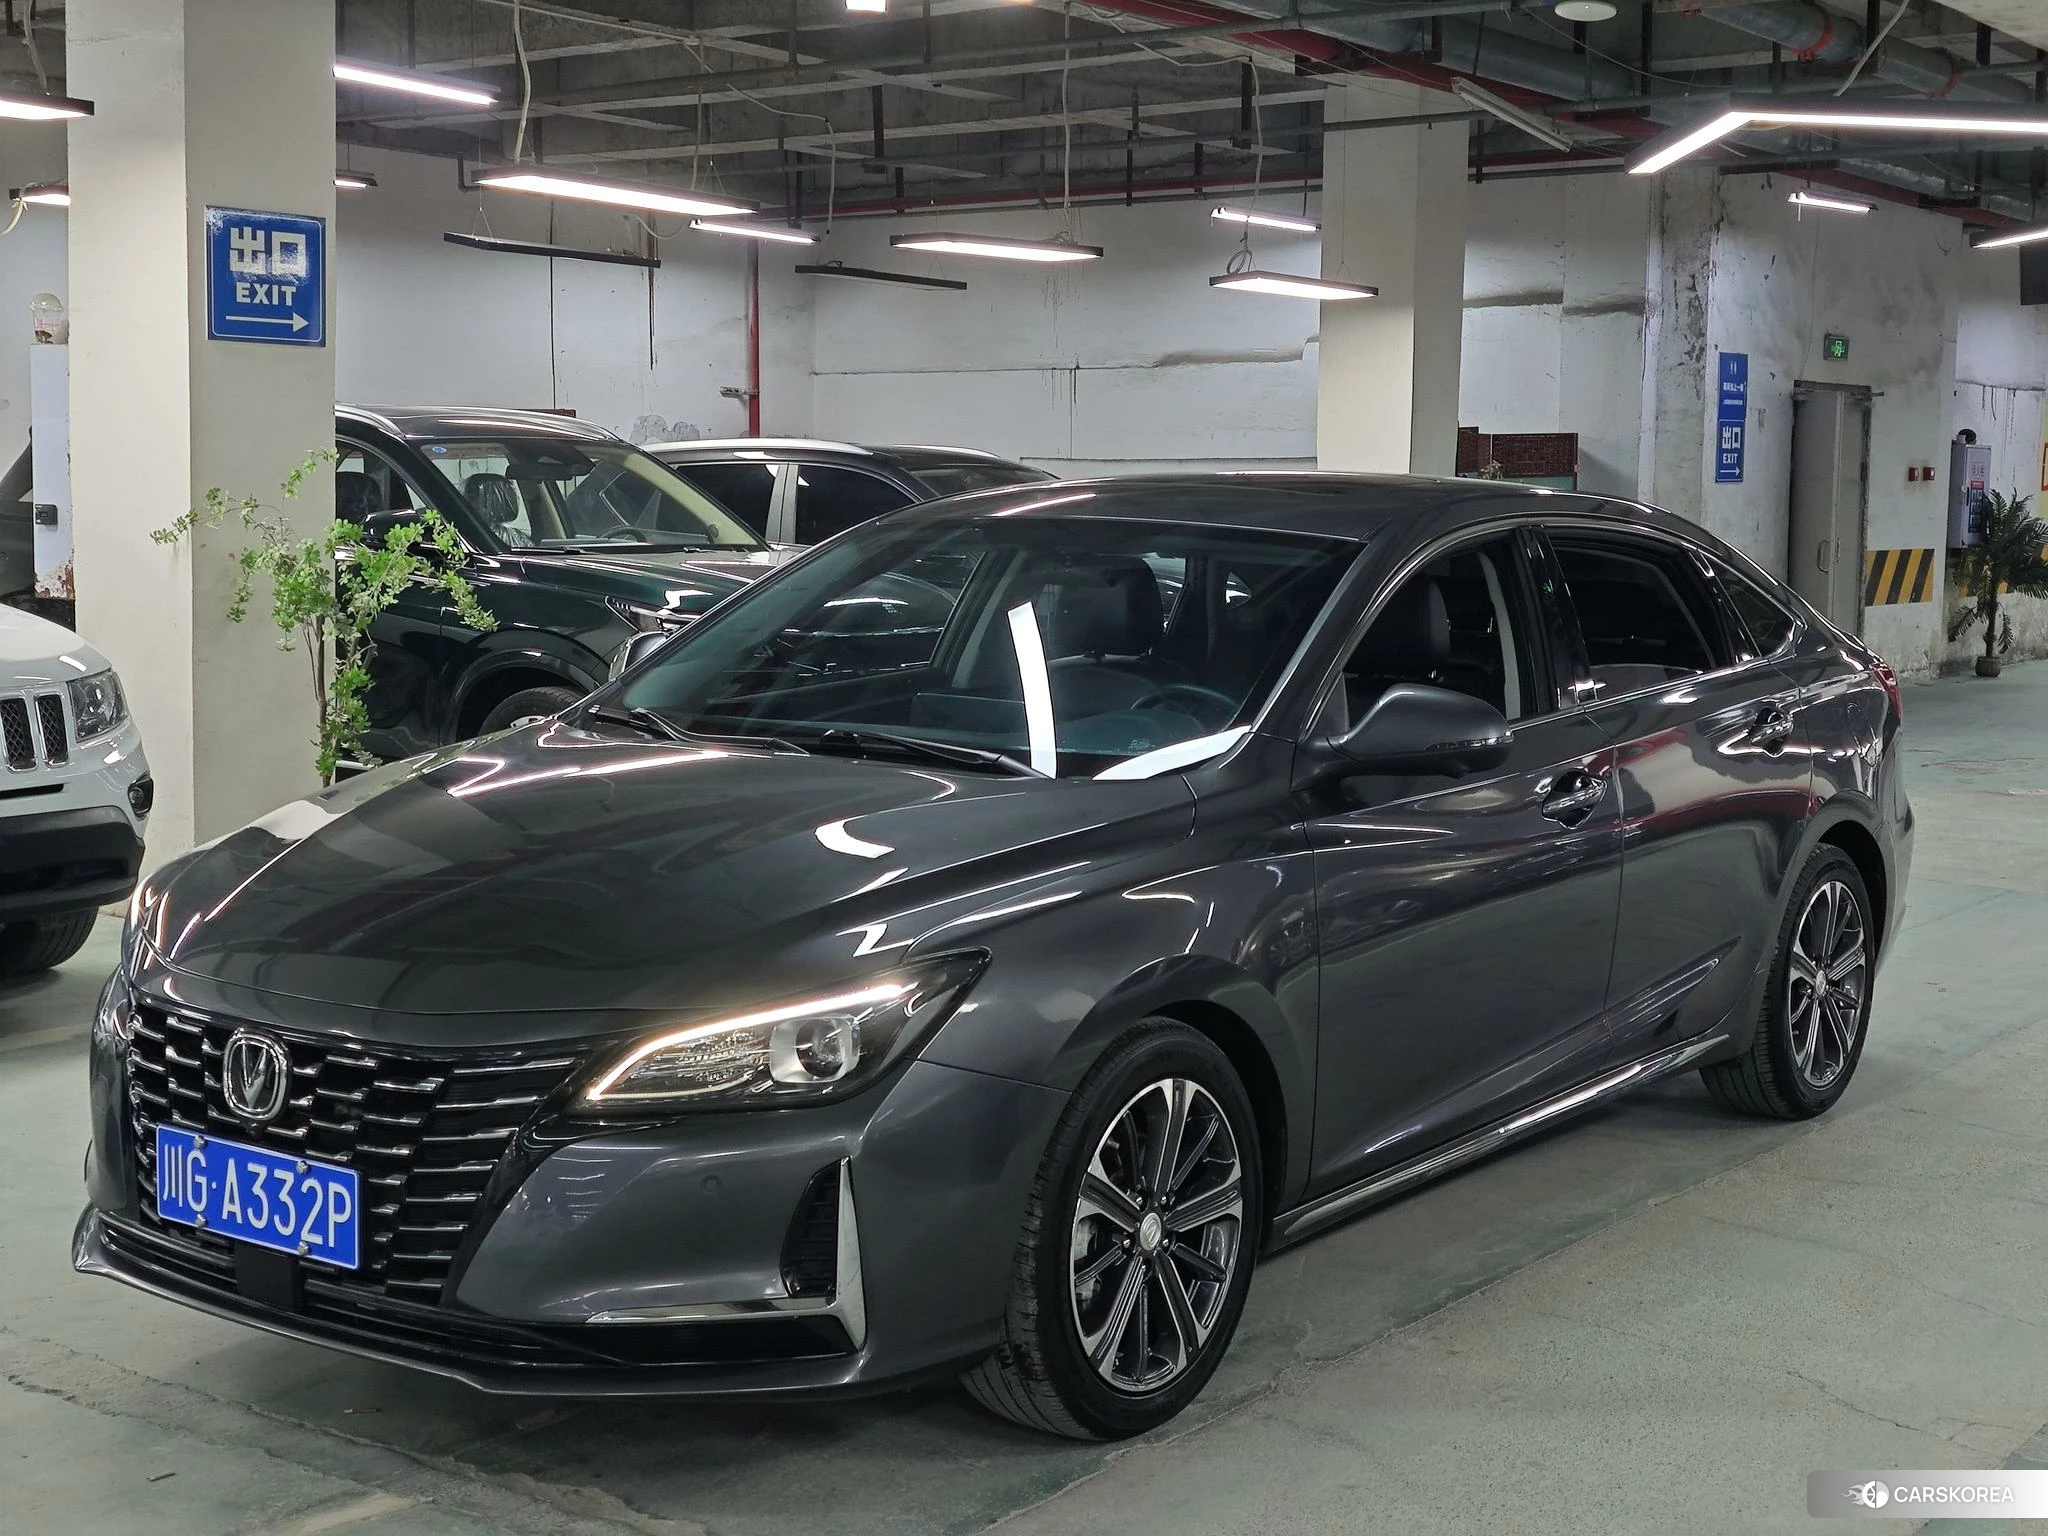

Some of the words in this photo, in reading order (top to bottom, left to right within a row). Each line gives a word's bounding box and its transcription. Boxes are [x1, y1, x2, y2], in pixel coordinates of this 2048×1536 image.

[230, 226, 306, 278] 出口
[236, 281, 297, 307] EXIT
[1722, 425, 1741, 449] 出口
[1723, 453, 1738, 464] EXIT
